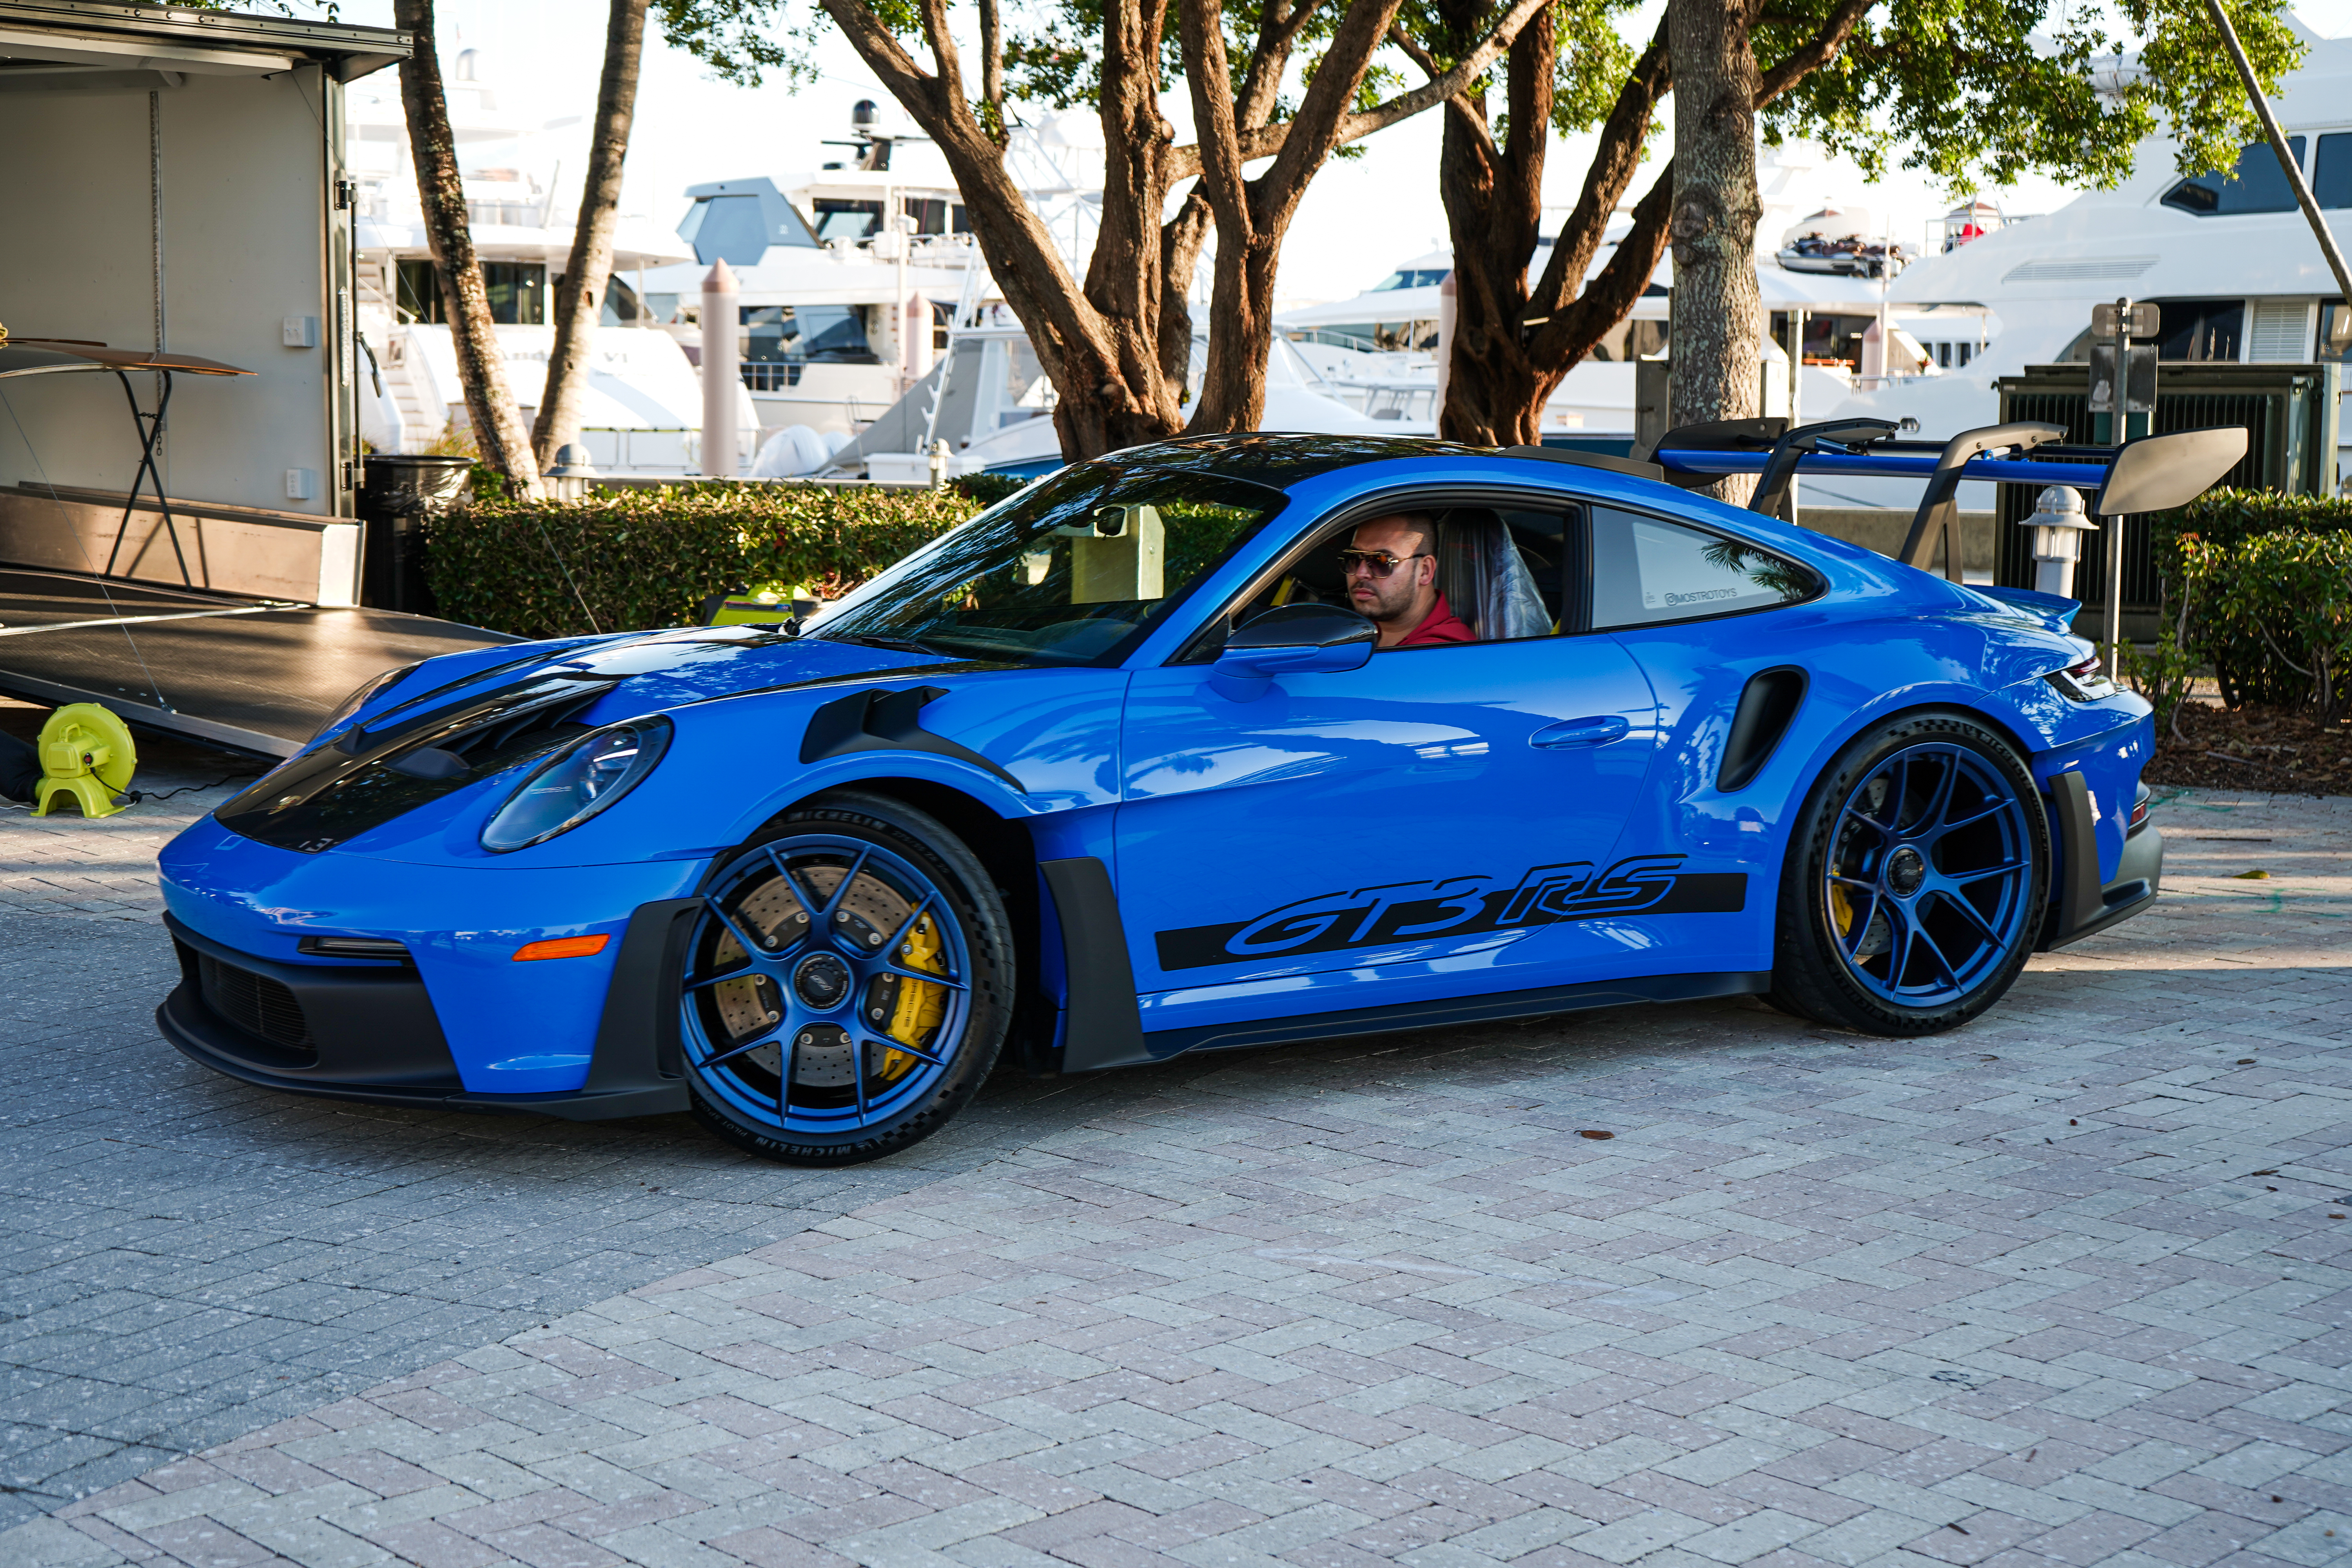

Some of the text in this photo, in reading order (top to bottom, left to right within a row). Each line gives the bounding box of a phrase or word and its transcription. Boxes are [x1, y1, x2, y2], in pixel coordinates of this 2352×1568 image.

[1980, 732, 2033, 789] MICHELIN
[788, 810, 887, 830] MICHELIN
[1225, 853, 1689, 955] GT3 RS
[721, 1121, 748, 1137] PILOT
[754, 1136, 851, 1157] MICHELIN
